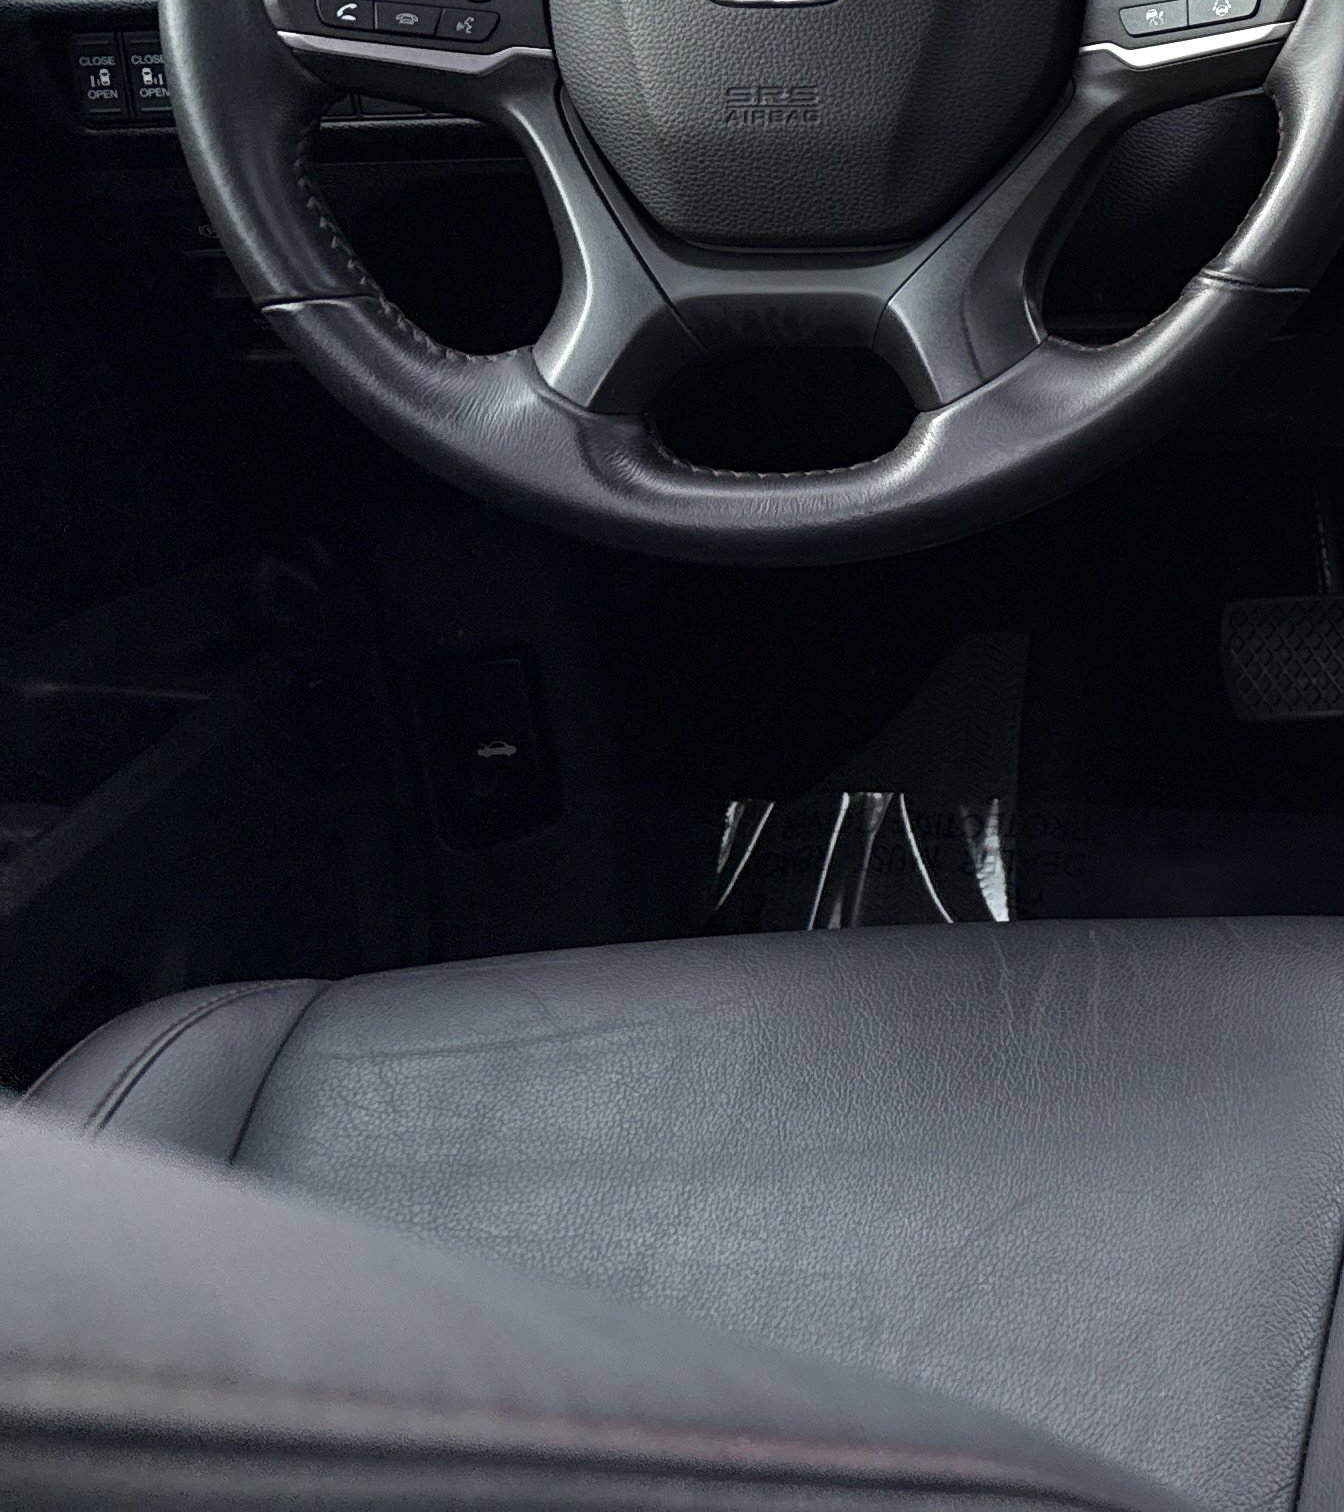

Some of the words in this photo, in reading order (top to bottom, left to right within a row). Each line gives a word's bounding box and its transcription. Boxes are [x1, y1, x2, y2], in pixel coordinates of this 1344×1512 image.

[79, 55, 116, 67] CLOSE
[87, 89, 119, 99] OPEN
[139, 87, 170, 98] OPEN
